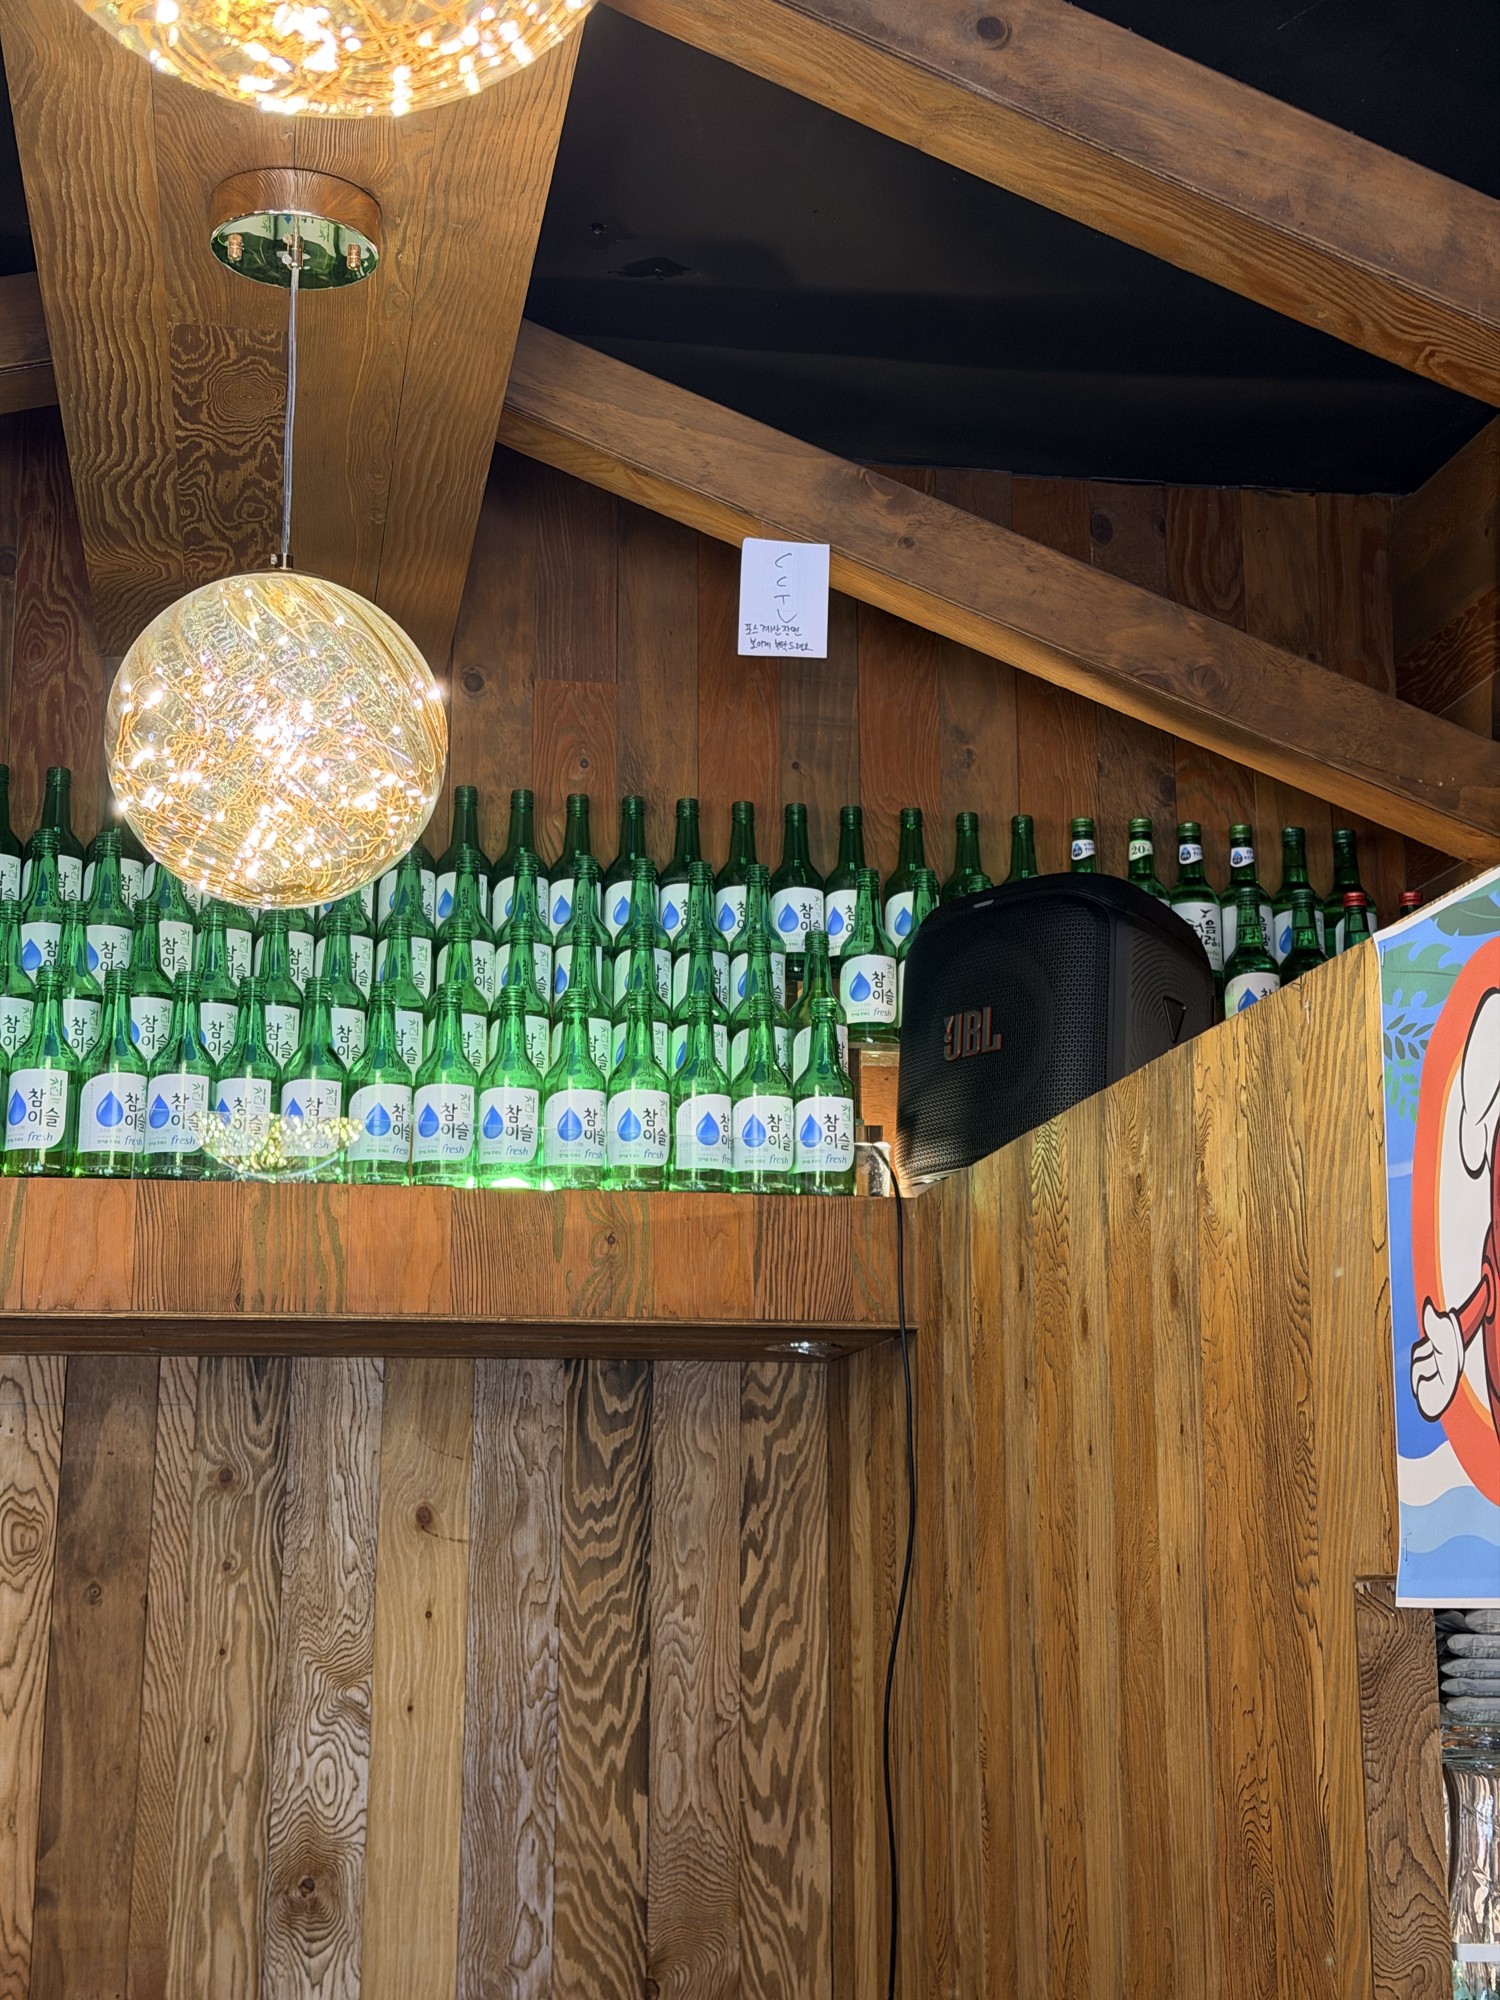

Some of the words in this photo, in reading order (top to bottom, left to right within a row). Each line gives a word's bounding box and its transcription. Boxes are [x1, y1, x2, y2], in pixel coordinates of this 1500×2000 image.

[774, 552, 798, 623] CCTV
[871, 971, 894, 1006] 참이슬
[873, 1007, 892, 1017] fresh
[944, 1007, 1003, 1062] JBL
[27, 1088, 60, 1128] 참이슬
[440, 1102, 469, 1141] 참이슬
[505, 1104, 534, 1143] 참이슬
[27, 1131, 54, 1142] fresh
[171, 1135, 196, 1147] fresh
[583, 1107, 606, 1146] 참이슬
[642, 1107, 668, 1146] 참이슬
[766, 1113, 792, 1152] 참이슬
[823, 1113, 851, 1151] 참이슬
[441, 1144, 465, 1155] fresh
[505, 1145, 529, 1156] fresh
[643, 1148, 664, 1159] fresh
[769, 1154, 789, 1165] fresh
[825, 1153, 847, 1164] fresh
